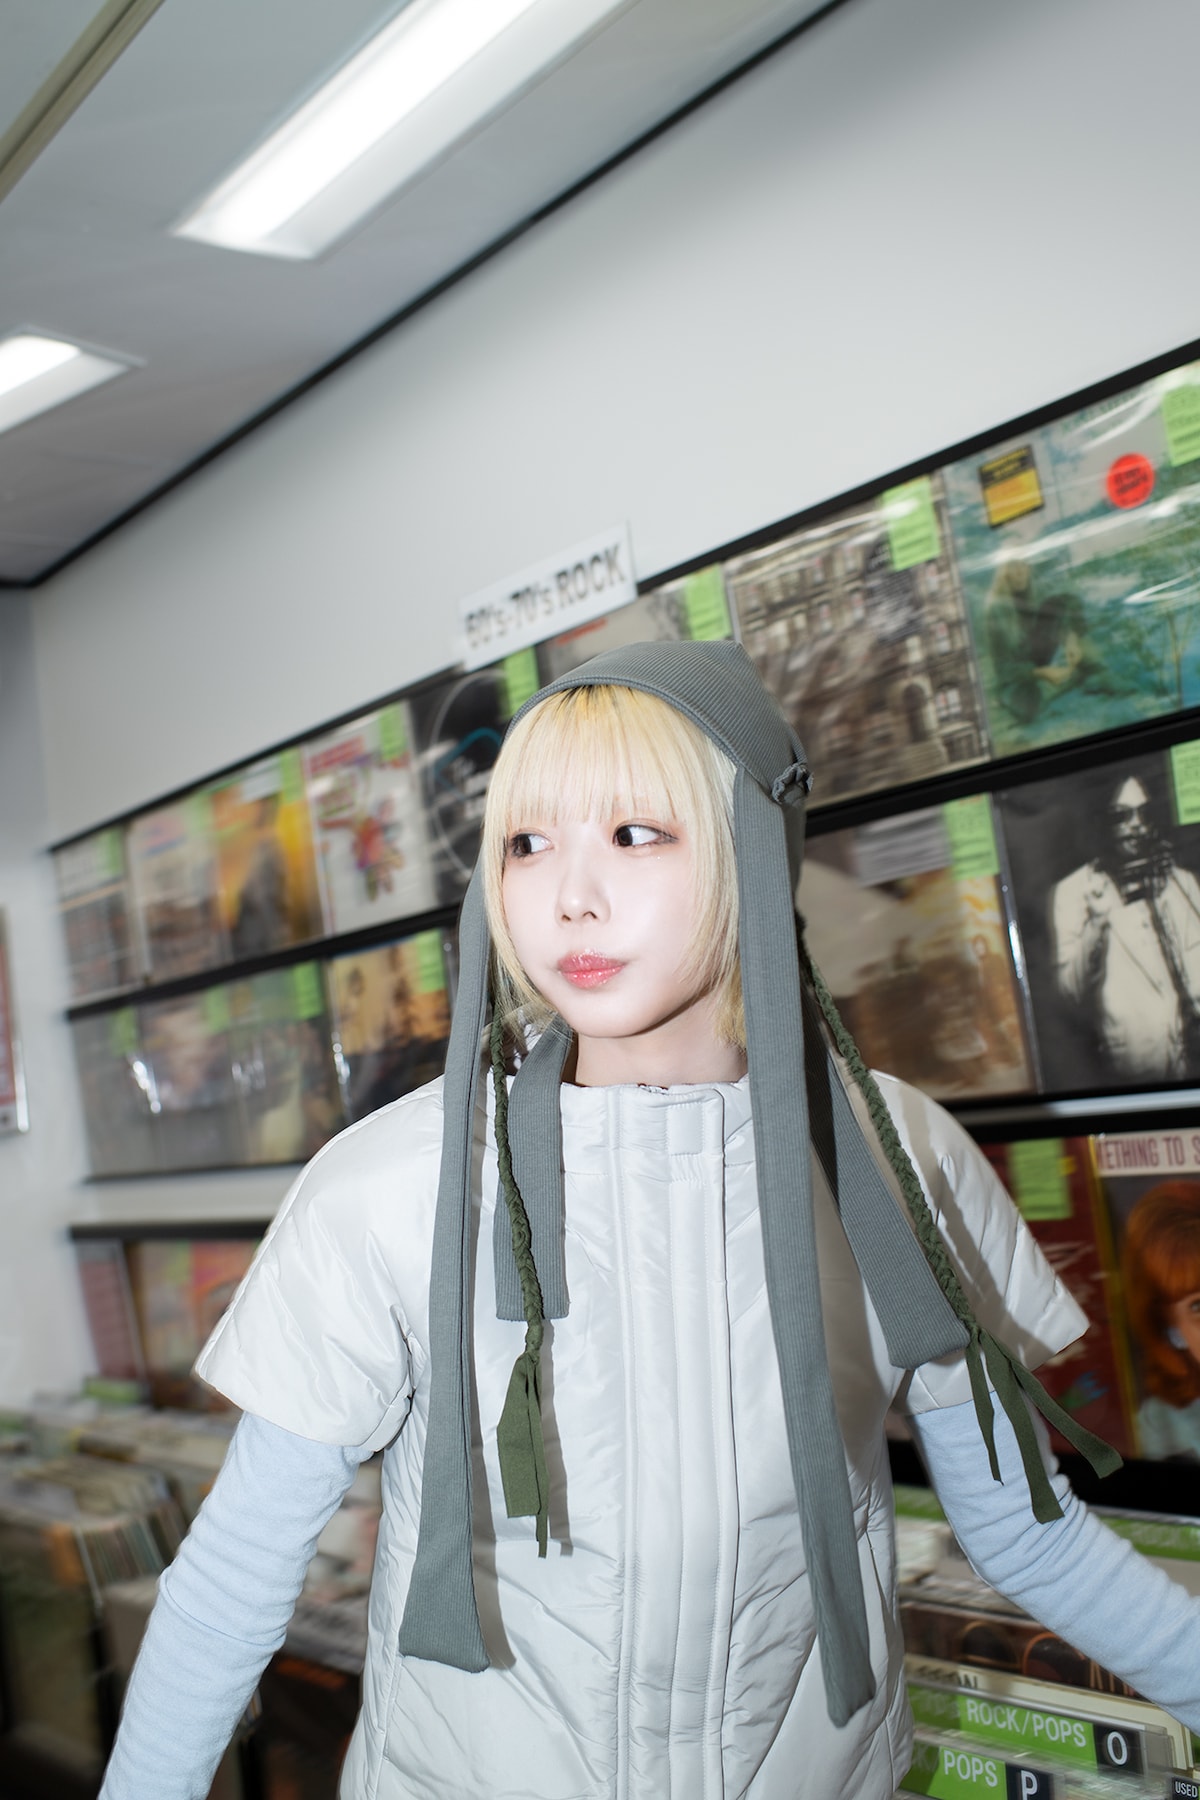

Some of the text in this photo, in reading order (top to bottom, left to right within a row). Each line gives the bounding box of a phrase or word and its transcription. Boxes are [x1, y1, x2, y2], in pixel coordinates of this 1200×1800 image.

[555, 544, 627, 609] ROCK
[1162, 1135, 1186, 1167] TO
[966, 1698, 1088, 1748] ROCK/POPS
[1020, 1769, 1039, 1800] P
[1175, 1781, 1199, 1798] USED
